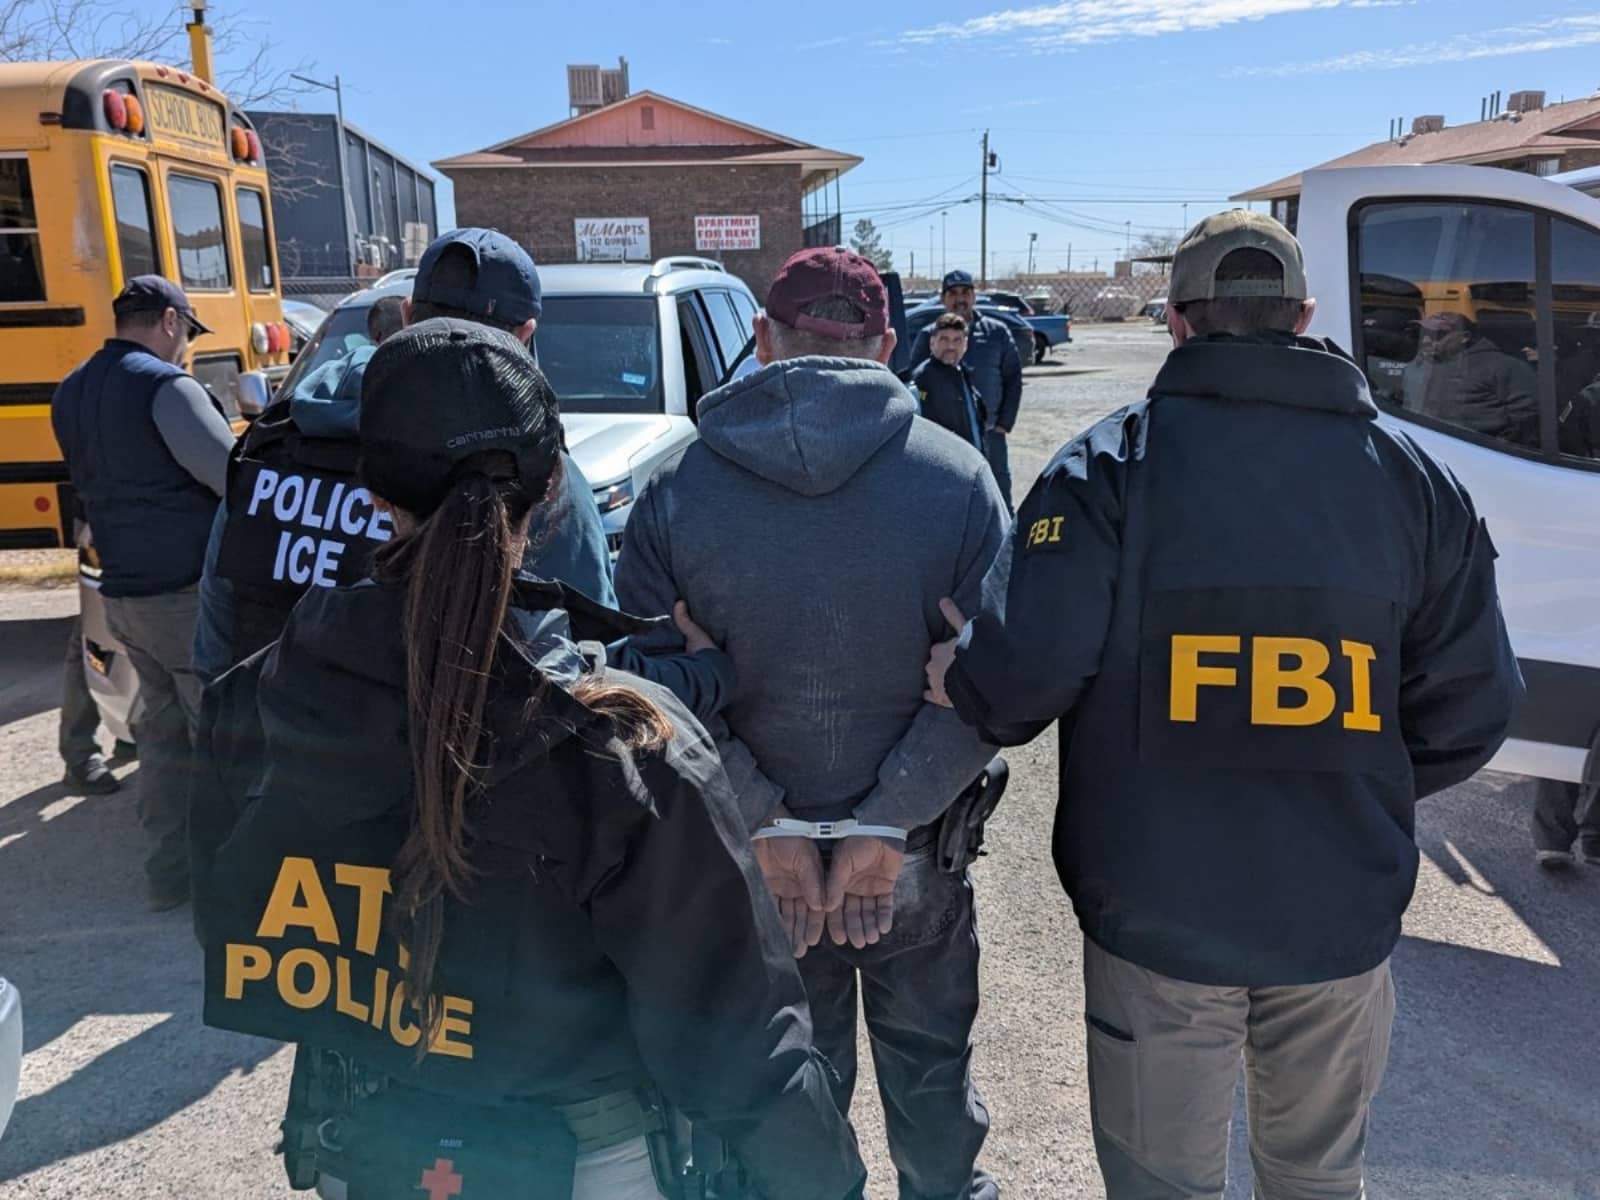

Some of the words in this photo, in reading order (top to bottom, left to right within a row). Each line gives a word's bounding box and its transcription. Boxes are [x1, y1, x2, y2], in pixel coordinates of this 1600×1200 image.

[151, 89, 198, 134] SCHOOL
[197, 103, 220, 142] BUS
[697, 218, 756, 227] APARTMENT
[697, 229, 721, 238] FOR
[725, 229, 756, 238] RENT
[247, 468, 394, 542] POLICE
[272, 531, 346, 588] ICE
[1170, 634, 1382, 732] FBI
[256, 856, 411, 970] AT
[224, 943, 475, 1060] POLICE
